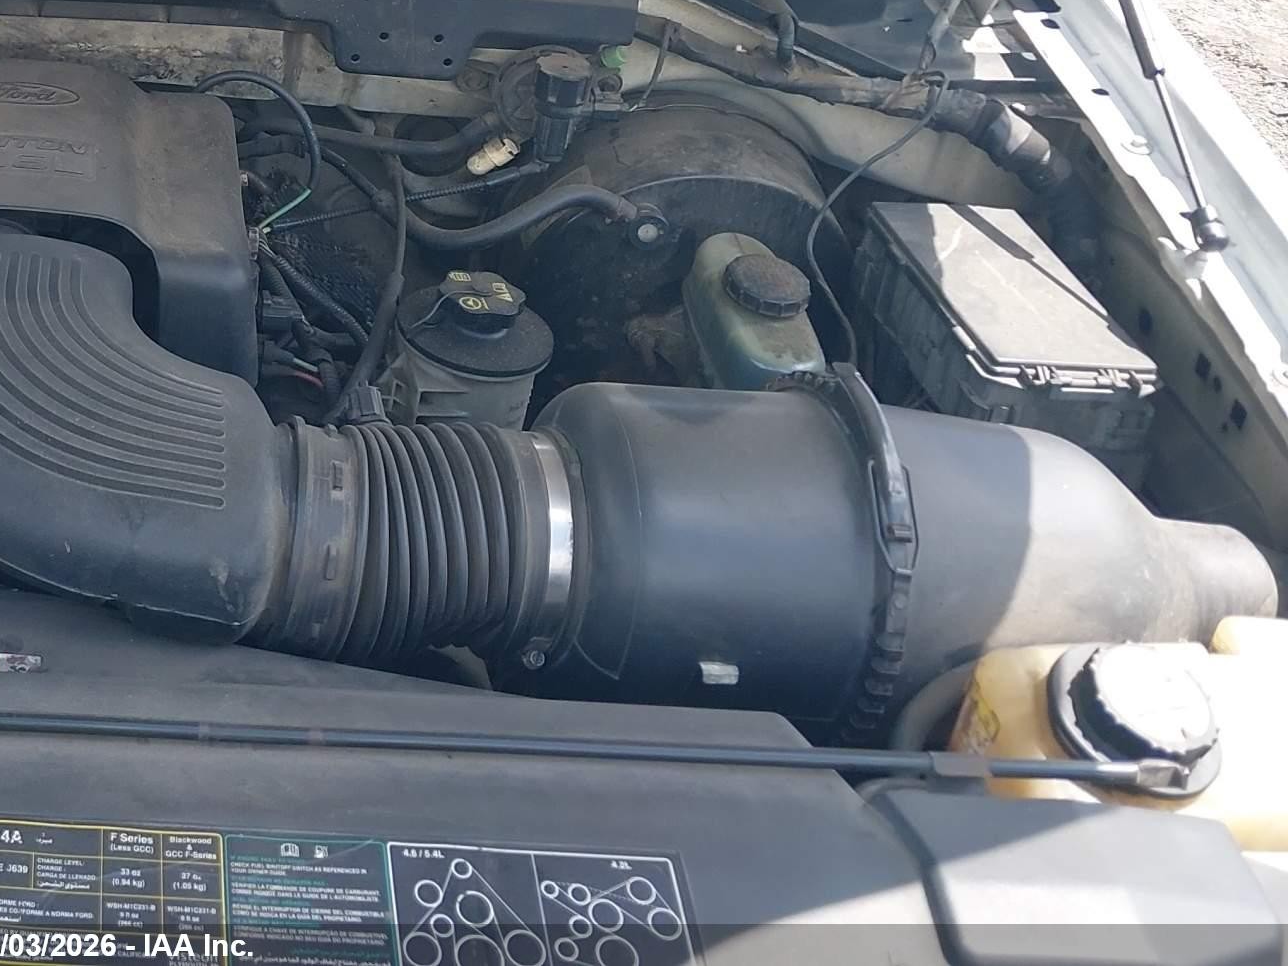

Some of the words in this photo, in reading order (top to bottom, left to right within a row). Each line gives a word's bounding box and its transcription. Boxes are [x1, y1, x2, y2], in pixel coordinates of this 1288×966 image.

[110, 832, 117, 842] F
[119, 833, 154, 845] Series
[169, 836, 213, 845] Blackwood
[110, 842, 132, 852] (Less
[133, 843, 155, 854] GCC)
[185, 850, 218, 861] F-Series
[37, 857, 63, 865] CHARGE
[6, 864, 29, 874] J639
[36, 871, 59, 880] CARGA
[131, 878, 146, 888] kg)
[193, 882, 207, 892] kg)
[51, 910, 74, 918] NORMA
